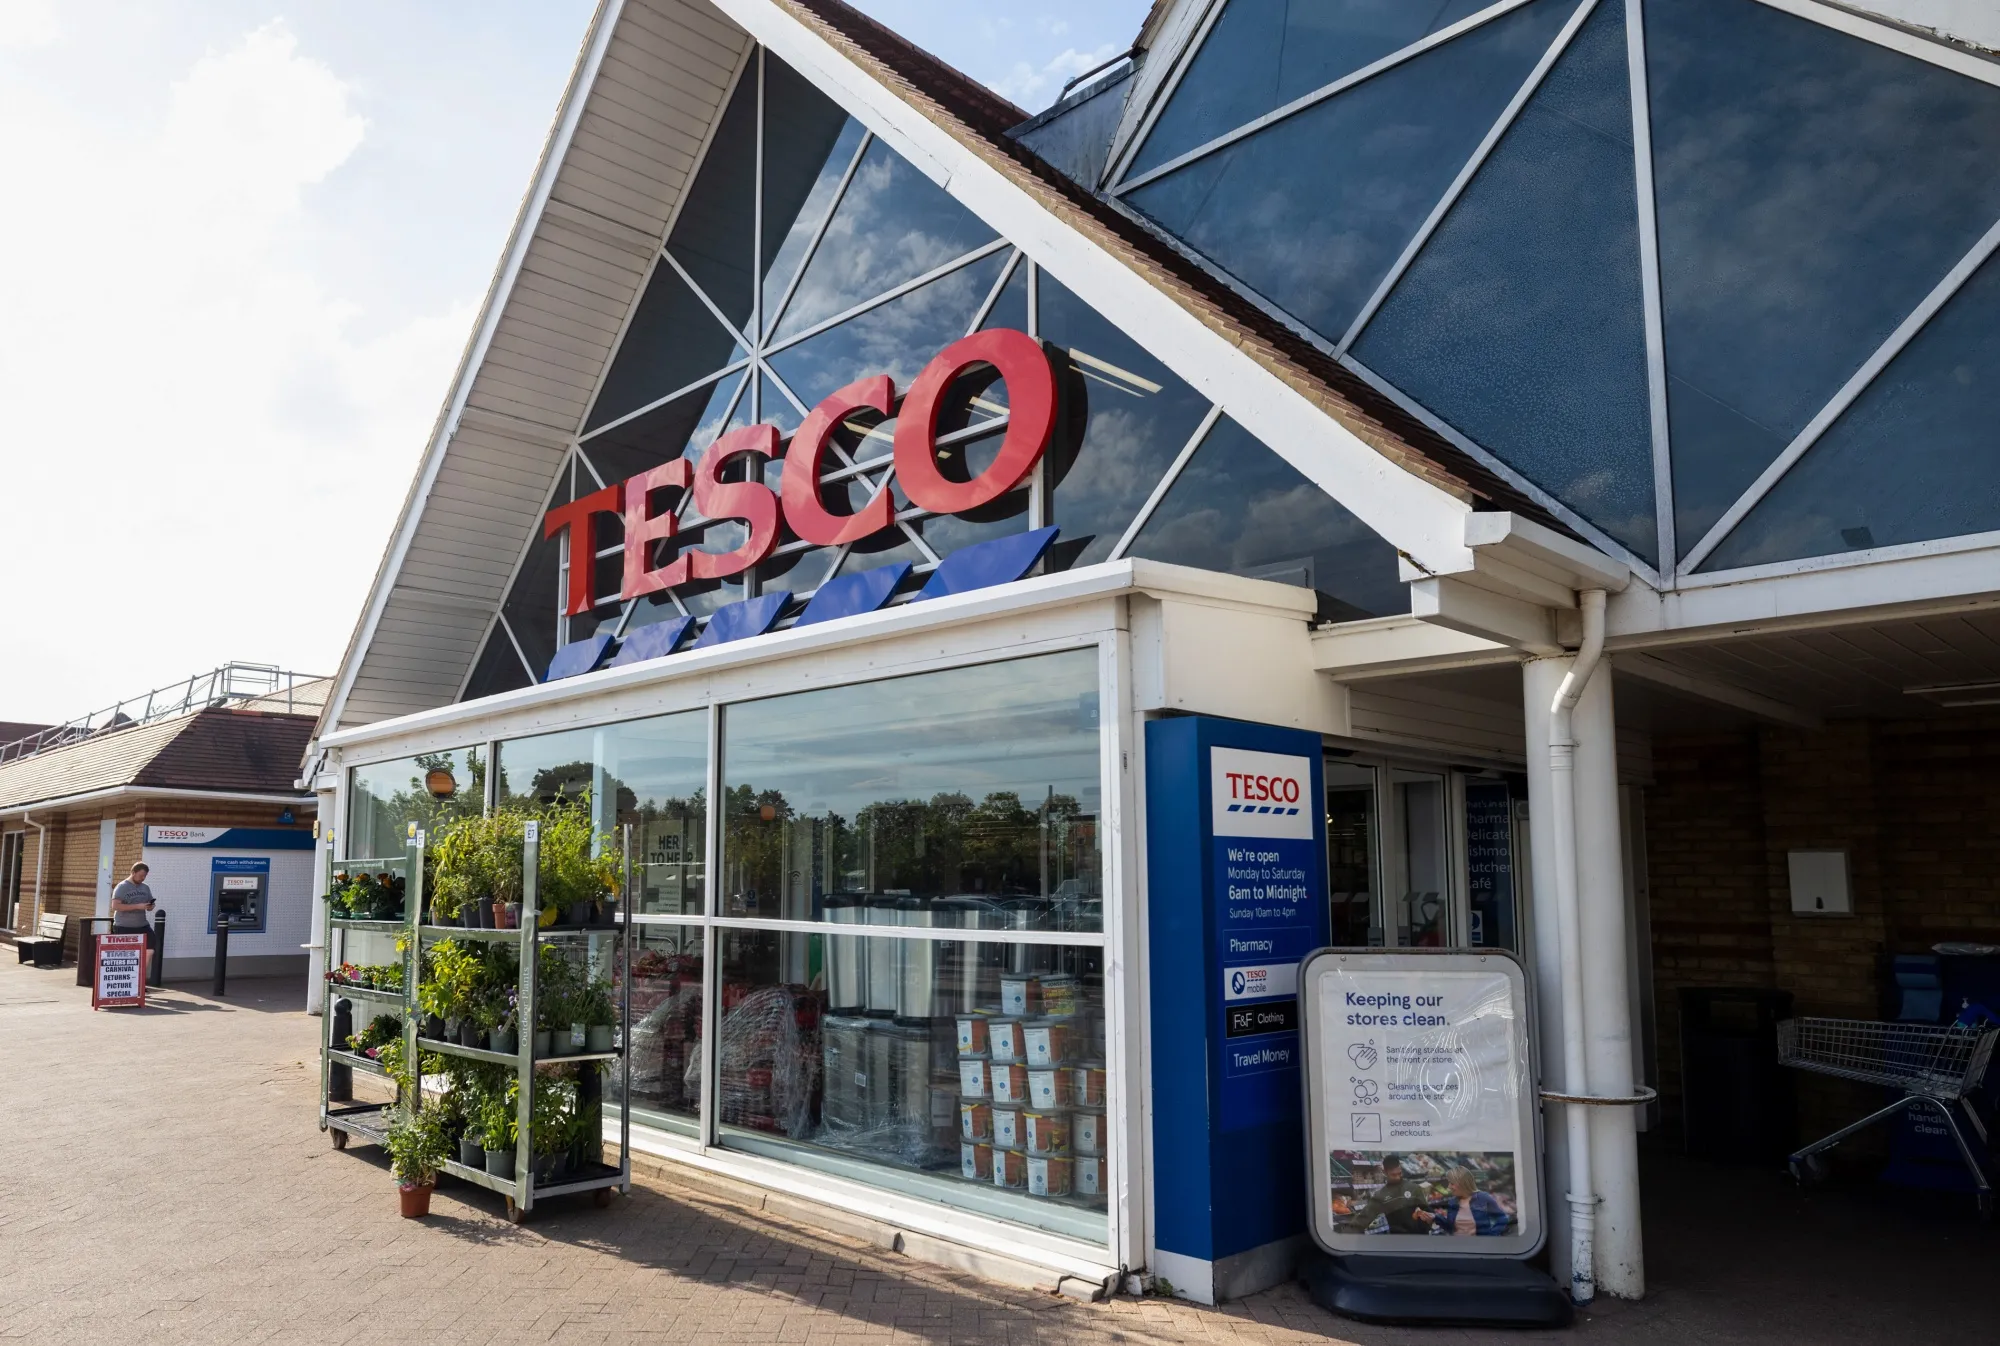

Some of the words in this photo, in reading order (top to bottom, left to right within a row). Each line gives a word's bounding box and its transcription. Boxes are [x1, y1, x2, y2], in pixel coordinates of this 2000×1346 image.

[545, 328, 1058, 616] TESCO
[1226, 772, 1300, 804] TESCO
[1466, 800, 1487, 808] hat's
[1466, 813, 1509, 824] harma
[1227, 848, 1256, 862] We're
[1257, 851, 1280, 865] open
[1468, 845, 1511, 857] ishmo
[650, 852, 664, 867] TO
[667, 851, 694, 867] HEP
[1468, 861, 1512, 873] utcher
[1228, 867, 1260, 883] Monday
[1261, 867, 1271, 880] to
[1272, 867, 1306, 883] Saturday
[1469, 877, 1492, 889] afé
[1228, 885, 1251, 900] 6am
[1253, 886, 1265, 900] to
[1266, 885, 1307, 903] Midnight
[1229, 908, 1254, 920] Sunday
[1255, 907, 1273, 917] 10am
[1273, 908, 1281, 917] to
[1282, 907, 1297, 919] 4pm
[1230, 938, 1273, 953] Pharmacy
[105, 950, 136, 958] TIMES
[1246, 970, 1267, 978] TESCO
[522, 967, 530, 999] Plants
[1246, 983, 1267, 993] mobile
[1345, 992, 1411, 1010] Keeping
[1415, 995, 1444, 1007] our
[521, 1003, 530, 1047] Outdoor
[1233, 1012, 1253, 1030] F&F
[1257, 1012, 1284, 1025] Clothing
[1346, 1012, 1398, 1026] stores
[1402, 1012, 1451, 1026] clean.
[1233, 1051, 1261, 1067] Travel
[1262, 1048, 1290, 1065] Money
[1386, 1056, 1399, 1064] the
[1387, 1083, 1421, 1093] Cleaning
[1388, 1093, 1417, 1101] around
[1389, 1119, 1421, 1127] Screens
[1390, 1129, 1433, 1138] checkouts.
